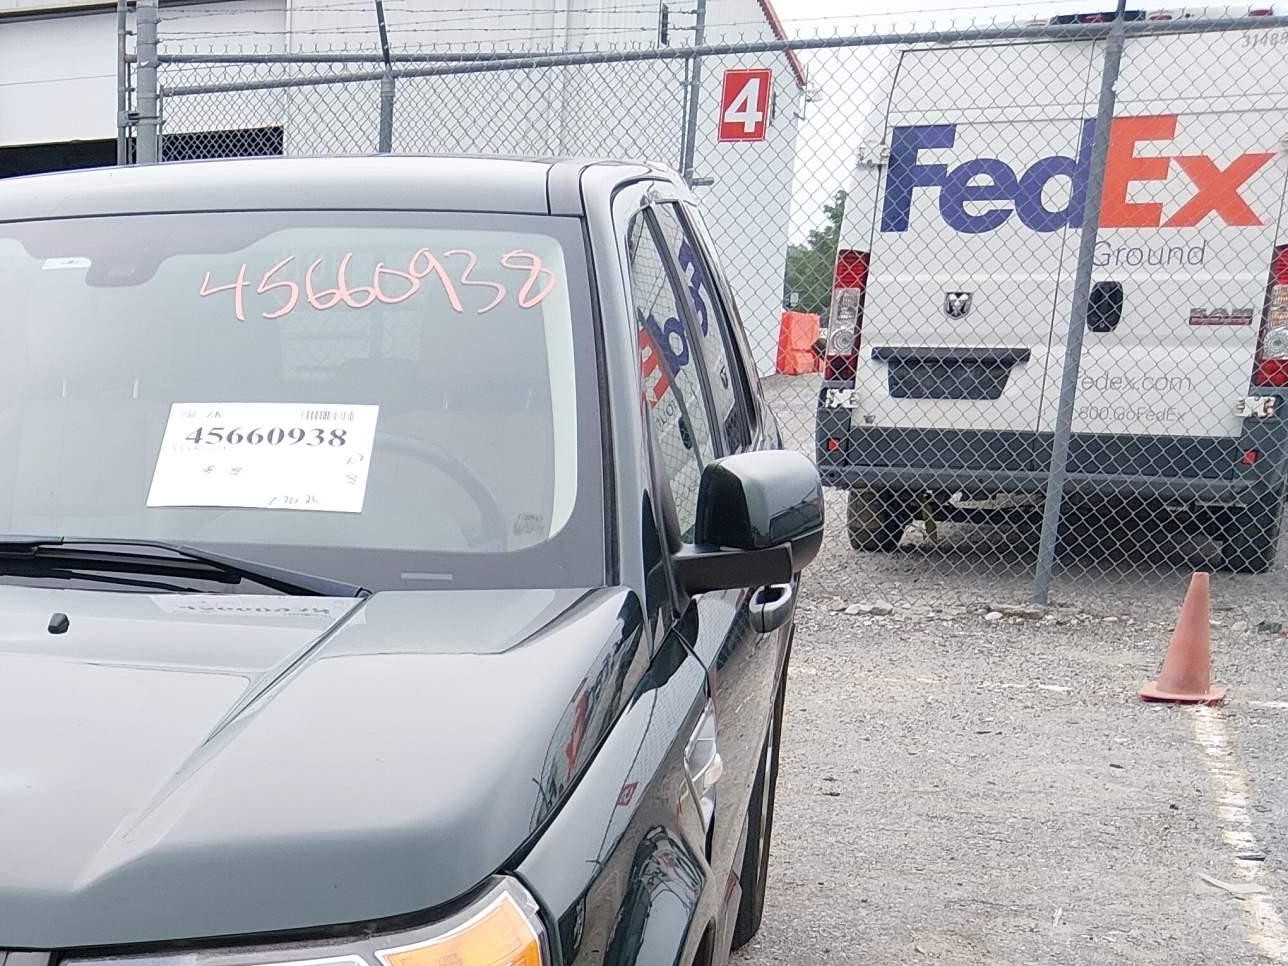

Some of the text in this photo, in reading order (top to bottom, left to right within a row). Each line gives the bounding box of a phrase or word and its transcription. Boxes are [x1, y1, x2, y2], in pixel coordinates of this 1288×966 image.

[724, 78, 763, 133] 4
[881, 114, 1277, 233] FedEx
[1094, 240, 1206, 267] Ground
[200, 247, 558, 321] 45660938
[1079, 371, 1192, 391] edex.com
[185, 426, 348, 448] 45660938
